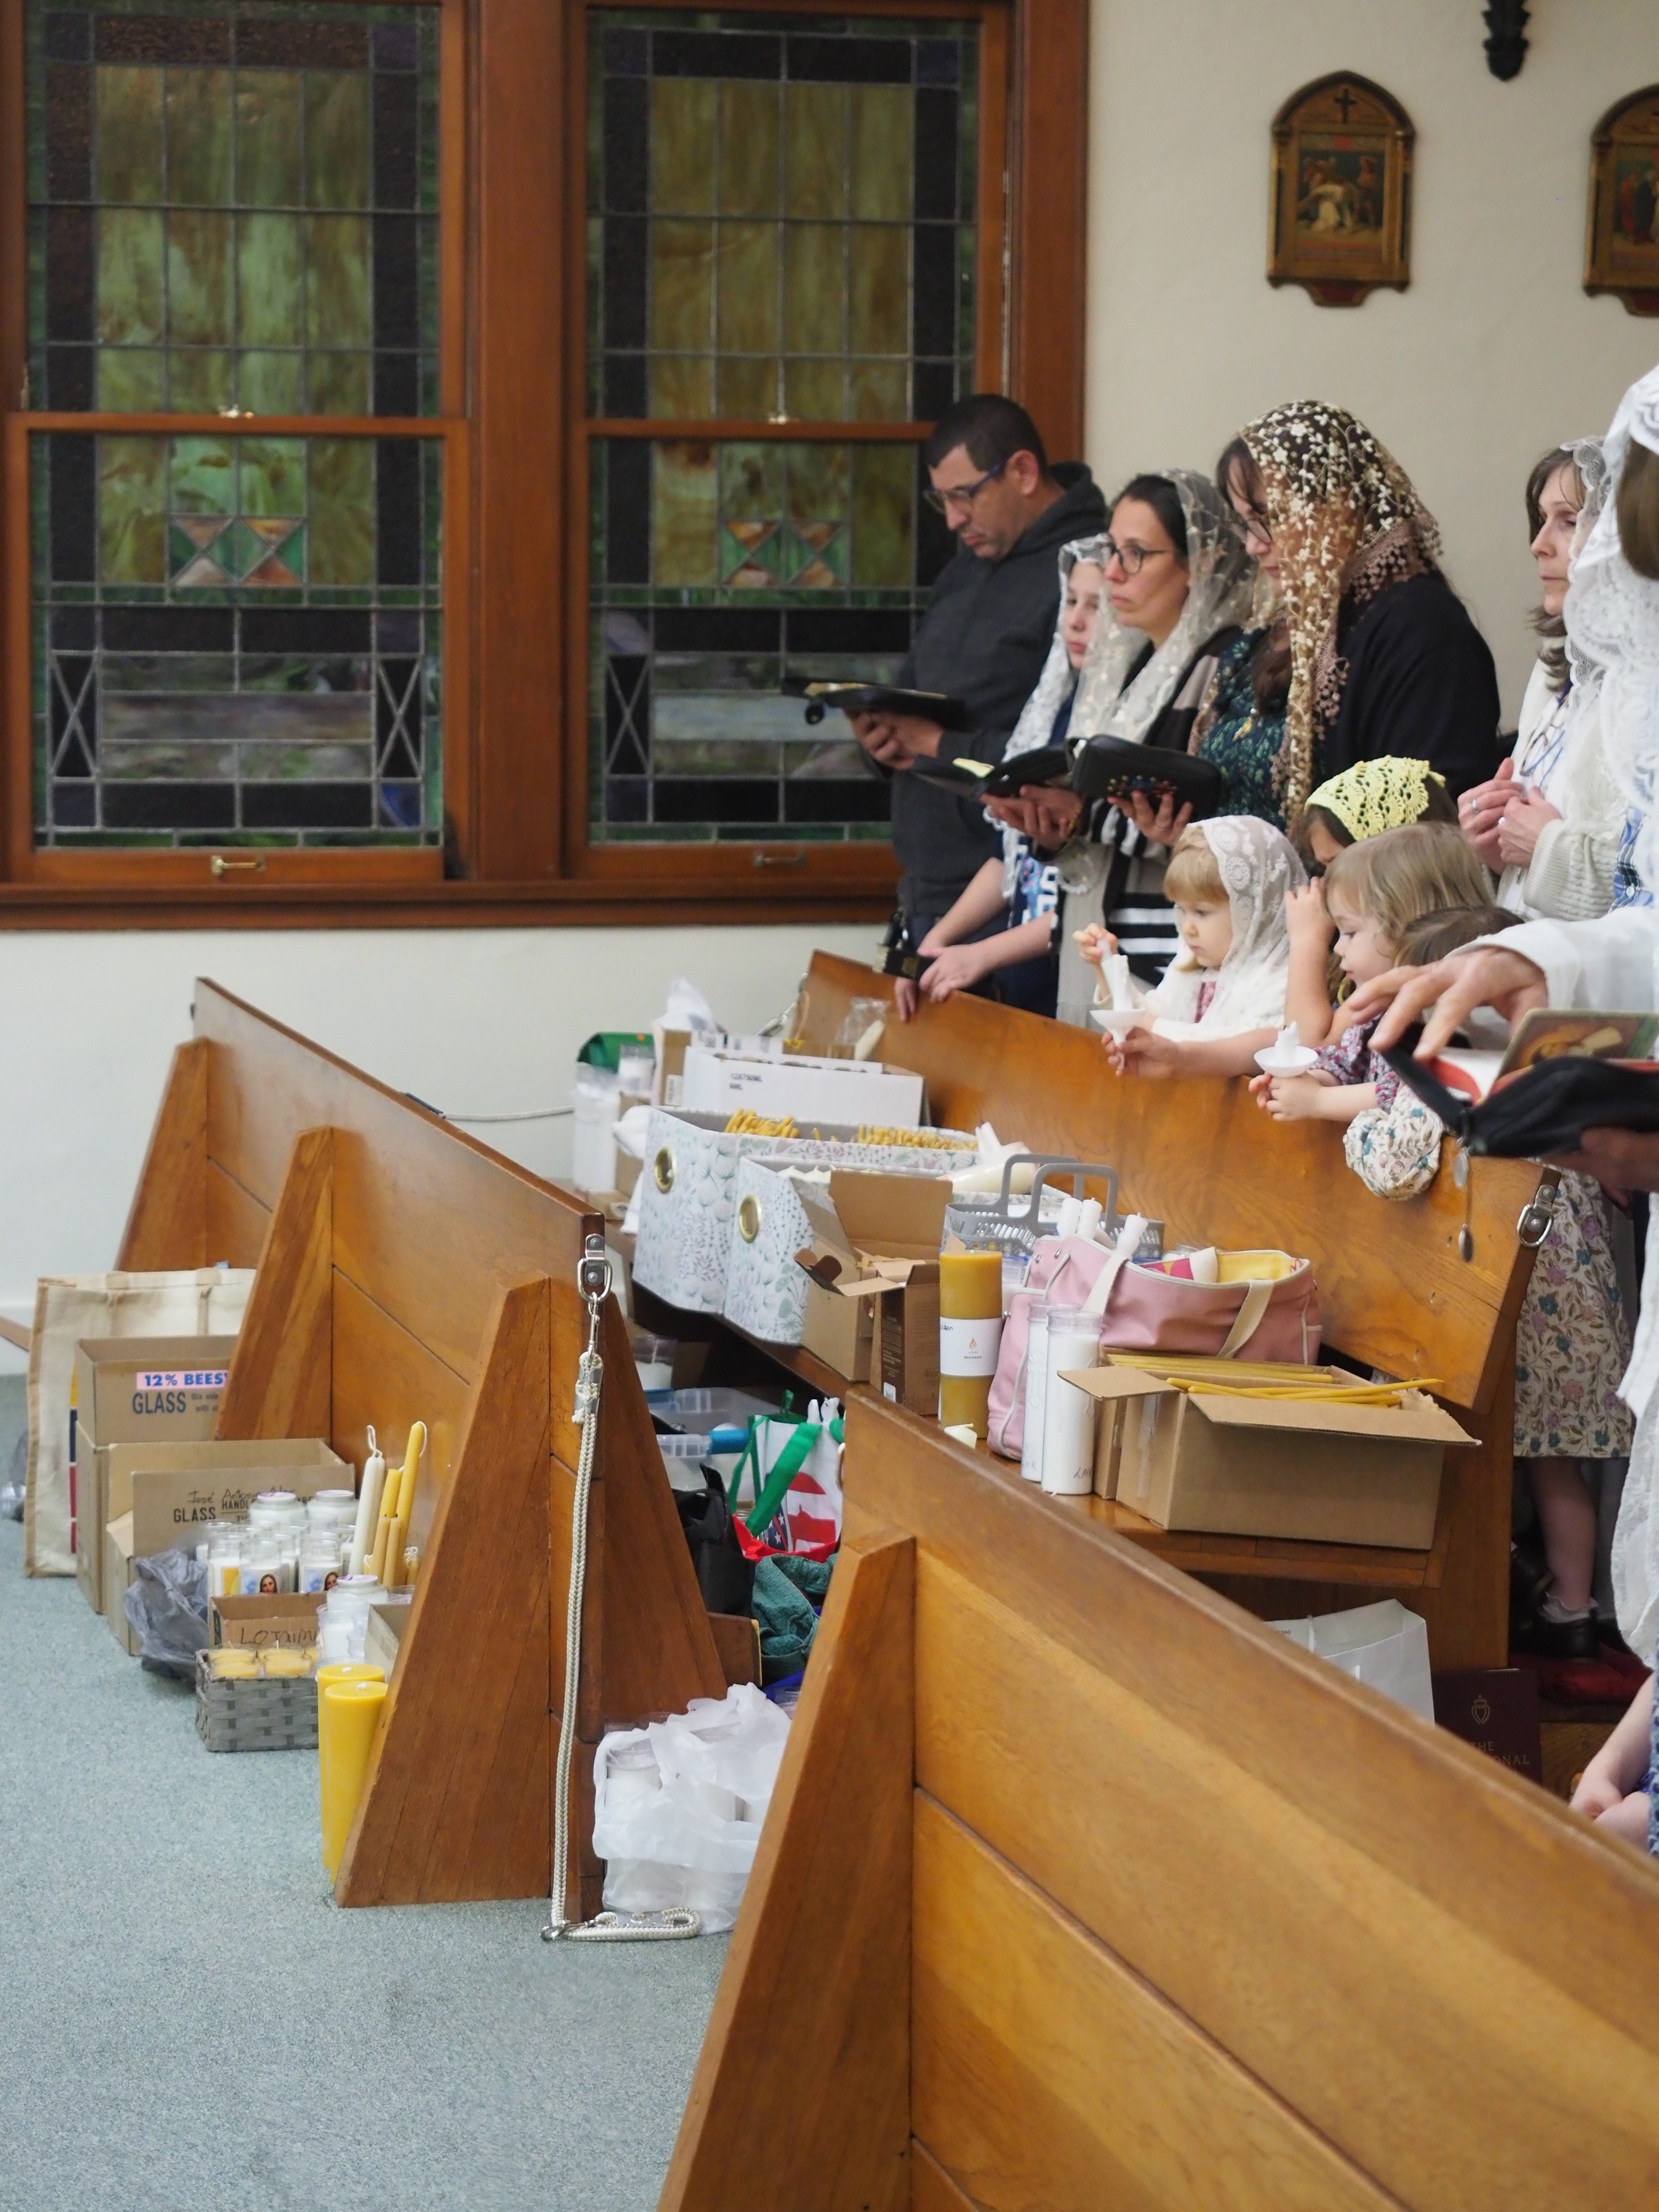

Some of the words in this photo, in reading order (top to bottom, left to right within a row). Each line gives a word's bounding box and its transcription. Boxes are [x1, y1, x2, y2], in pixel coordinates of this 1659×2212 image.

[145, 1374, 178, 1386] 12%
[184, 1372, 228, 1385] BEES
[132, 1391, 186, 1414] GLASS
[174, 1506, 216, 1523] GLASS
